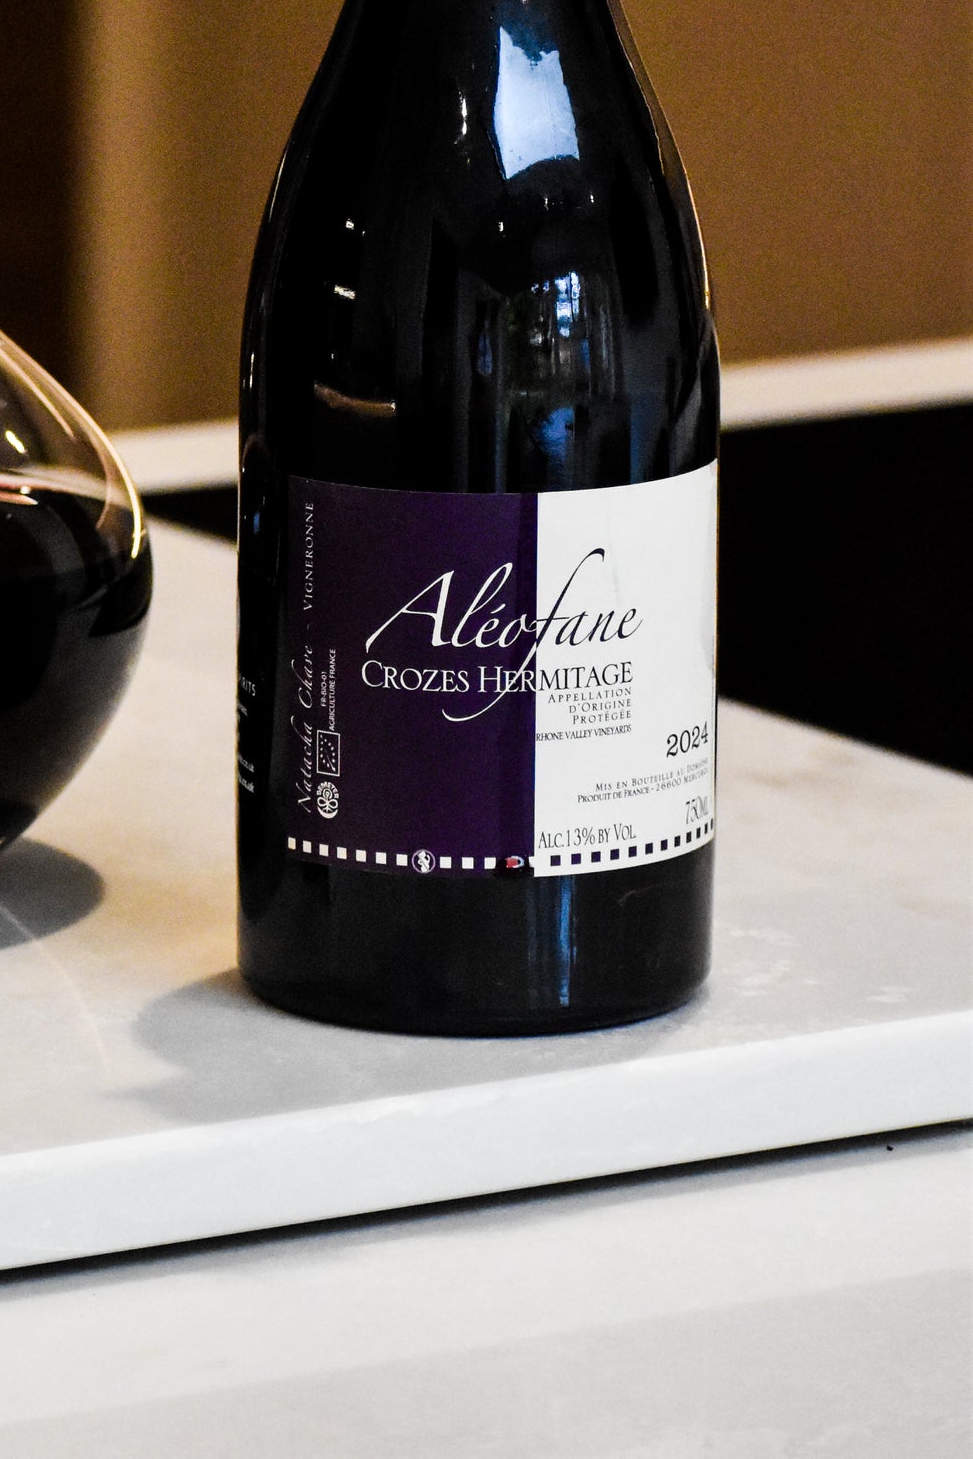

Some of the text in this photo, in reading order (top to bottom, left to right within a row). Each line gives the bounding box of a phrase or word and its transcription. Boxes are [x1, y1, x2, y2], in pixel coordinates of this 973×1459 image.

[365, 548, 644, 723] Aléofane
[291, 715, 313, 813] Natacha
[303, 502, 314, 611] VIGNERONNE
[320, 670, 328, 707] FR-BIO-01
[361, 660, 634, 694] CROZES HERMITAGE
[328, 679, 336, 731] AGRICULTURE
[548, 687, 632, 704] APPELLATION
[569, 698, 632, 714] D'ORIGINE
[536, 724, 632, 742] RHONE VALLEY VINEYARDS
[666, 721, 709, 758] 2024
[316, 781, 340, 799] DEMETER
[577, 793, 611, 804] PRODUIT
[613, 790, 622, 800] DE
[624, 787, 649, 798] FRANCE
[656, 777, 682, 792] 26600
[595, 782, 612, 792] MIS
[616, 780, 628, 789] EN
[631, 770, 674, 787] BOUTEILLE
[598, 828, 610, 844] BY
